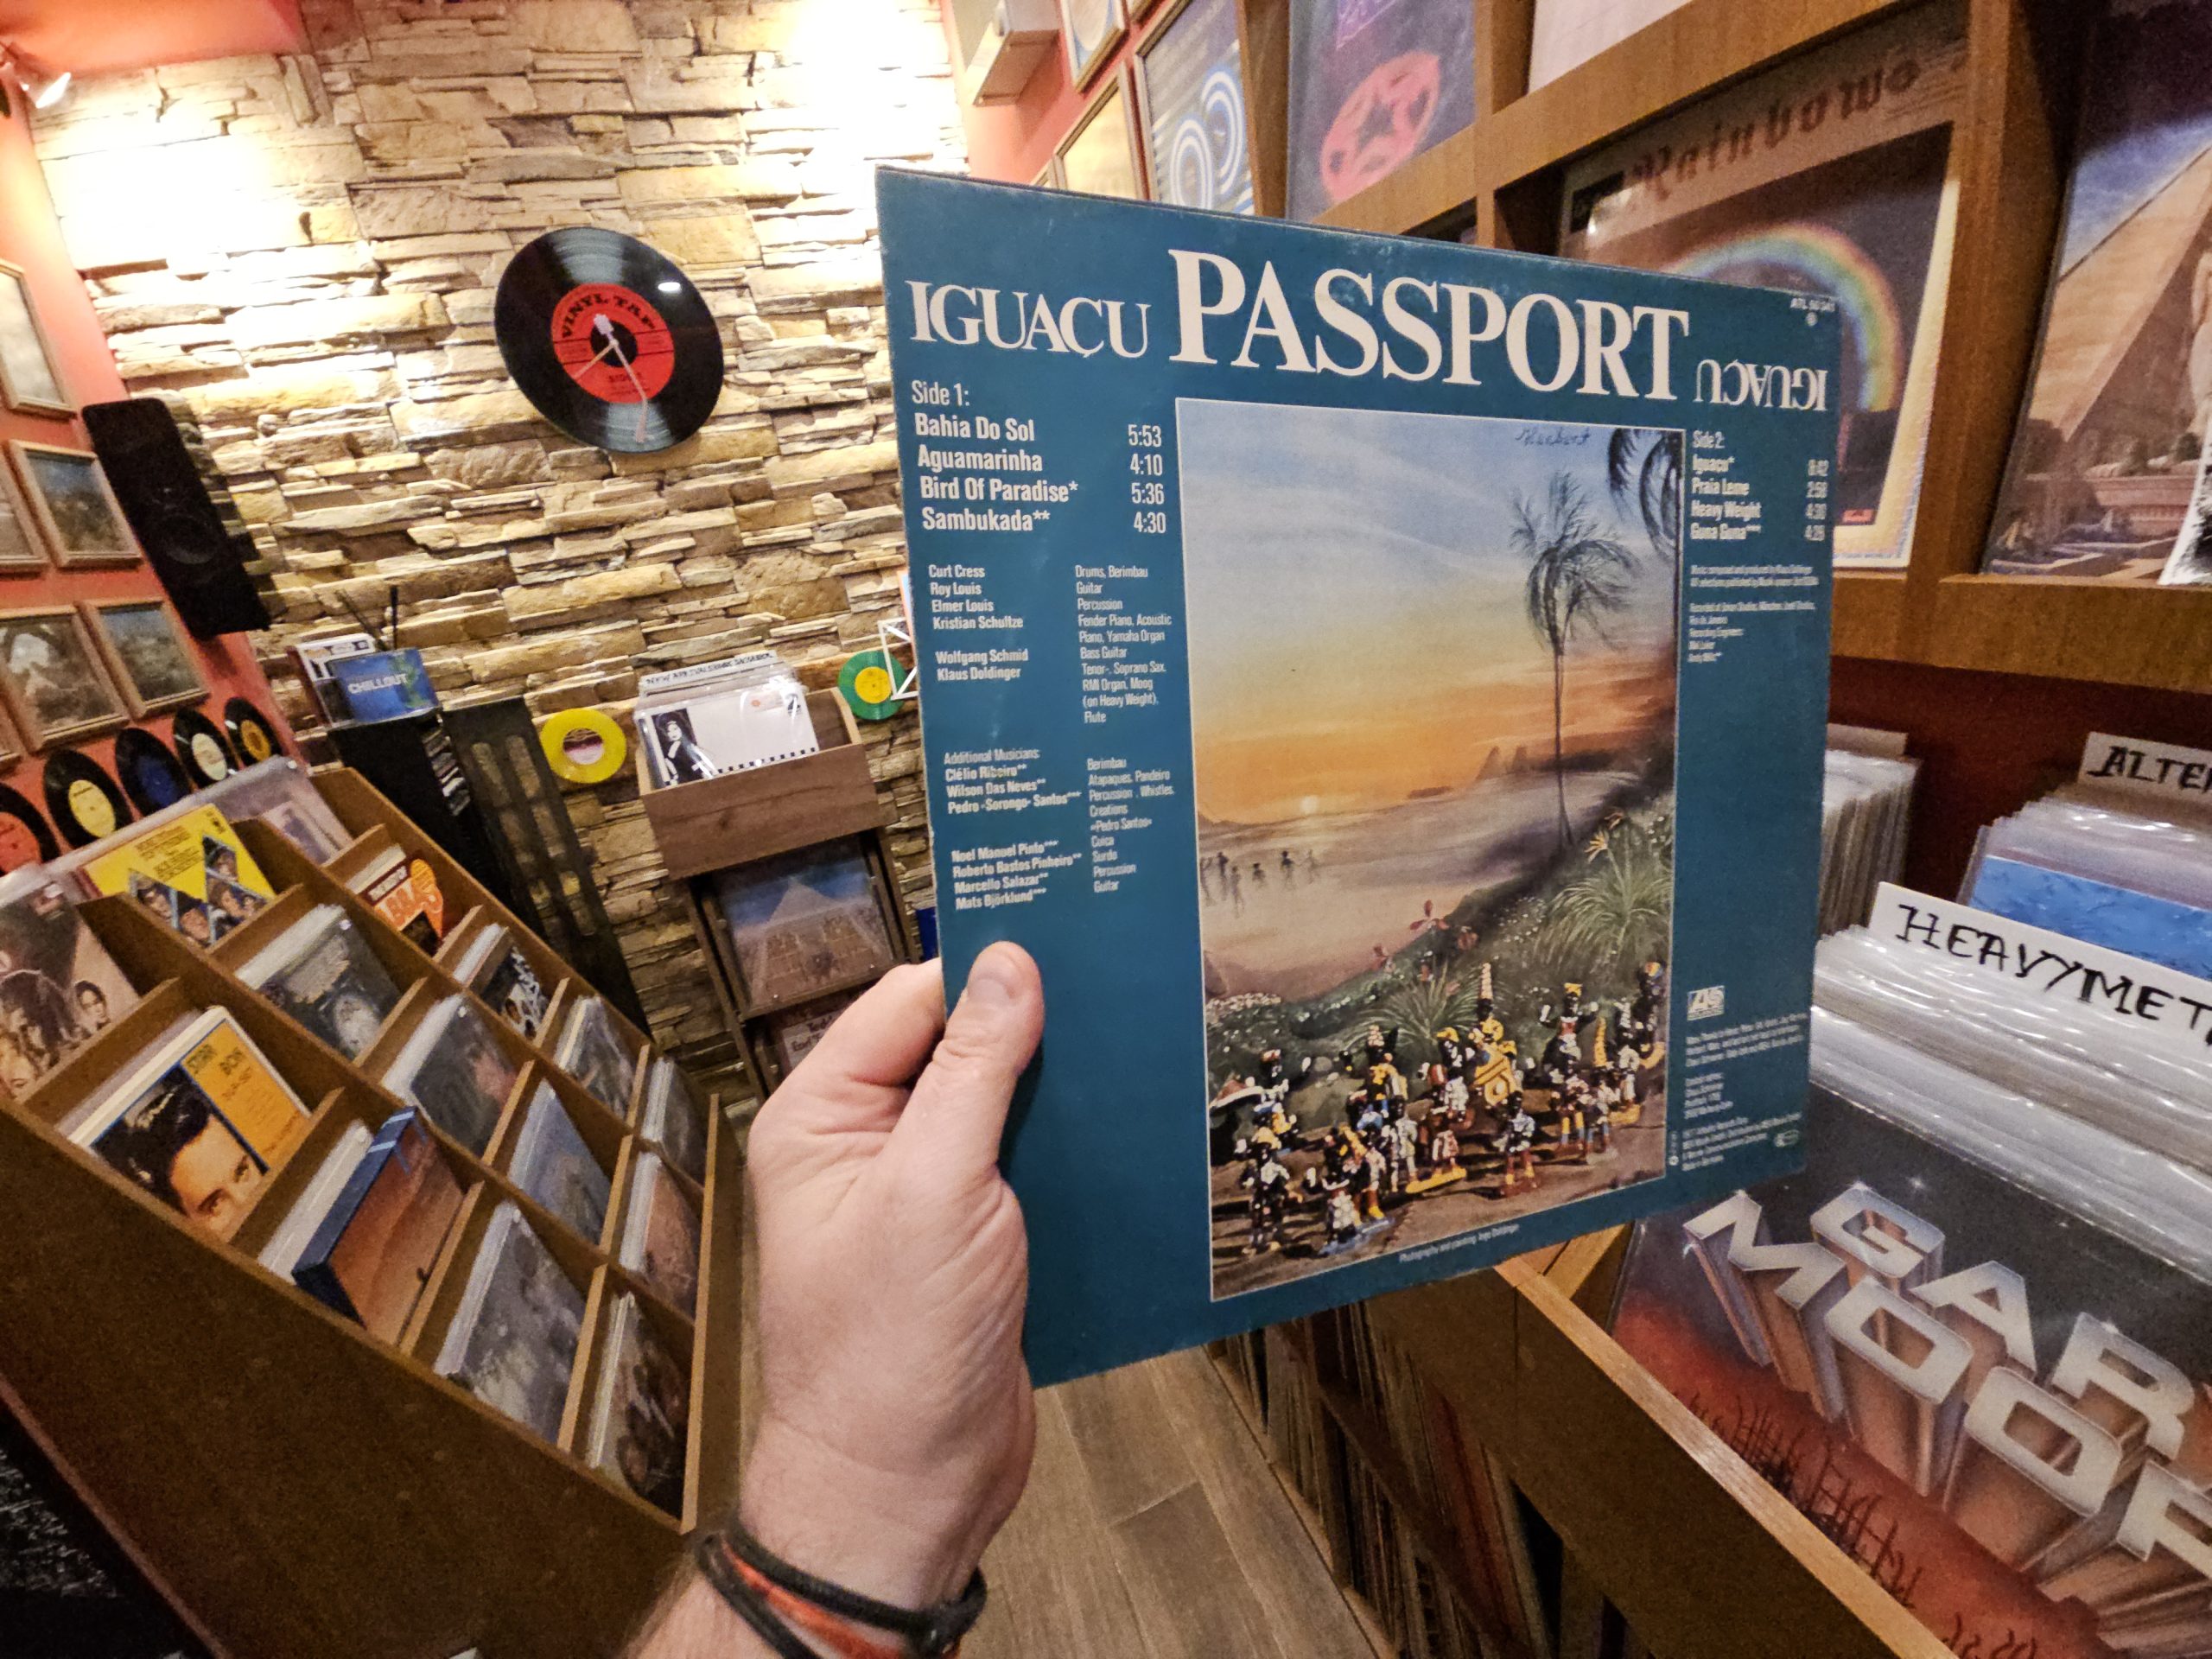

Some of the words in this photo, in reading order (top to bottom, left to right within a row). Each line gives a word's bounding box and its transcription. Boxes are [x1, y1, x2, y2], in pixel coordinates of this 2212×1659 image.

[562, 293, 608, 339] VINYL
[613, 295, 655, 331] TAP
[905, 280, 1152, 359] IGUAÇU
[1168, 249, 1689, 401] PASSPORT
[912, 379, 950, 406] Side
[954, 382, 970, 407] 1:
[914, 412, 971, 439] Bahia
[976, 416, 1000, 440] Do
[1005, 418, 1035, 442] Sol
[1128, 424, 1162, 448] 5:53
[918, 444, 1043, 473] Aguamarinha
[1129, 454, 1163, 476] 4:10
[920, 476, 959, 500] Bird
[964, 477, 984, 499] Of
[1131, 483, 1164, 505] 5:36
[1133, 512, 1166, 534] 4:30
[928, 564, 952, 578] Curt
[954, 564, 985, 578] Cress
[1109, 565, 1148, 578] Berimbau
[930, 582, 950, 597] Roy
[953, 582, 982, 595] Louis
[1077, 582, 1103, 594] Guitar
[931, 600, 963, 613] Elmer
[966, 599, 995, 612] Louis
[1077, 598, 1122, 610] Percussion
[932, 617, 976, 630] Kristian
[978, 616, 1023, 629] Schultze
[1078, 614, 1107, 627] Fender
[1136, 613, 1173, 626] Acoustic
[1107, 630, 1140, 642] Yamaha
[1141, 629, 1165, 644] Organ
[935, 651, 988, 664] Wolfgang
[989, 648, 1028, 662] Schmid
[1080, 647, 1100, 659] Bass
[1102, 646, 1128, 659] Guitar
[937, 668, 968, 682] Klaus
[970, 667, 1020, 681] Doldinger
[1113, 662, 1148, 676] Soprano
[347, 673, 408, 694] CHILLOUT
[1130, 677, 1154, 691] Moog
[1100, 695, 1124, 709] Heavy
[1084, 711, 1106, 723] Flute
[944, 750, 992, 765] Additional
[1087, 758, 1127, 771] Berimbau
[946, 785, 983, 798] Wilson
[985, 783, 1006, 795] Das
[948, 801, 979, 815] Pedro
[951, 849, 976, 862] Noel
[977, 844, 1016, 861] Manuel
[952, 865, 995, 879] Roberto
[1094, 880, 1120, 893] Guitar
[956, 897, 982, 911] Mats
